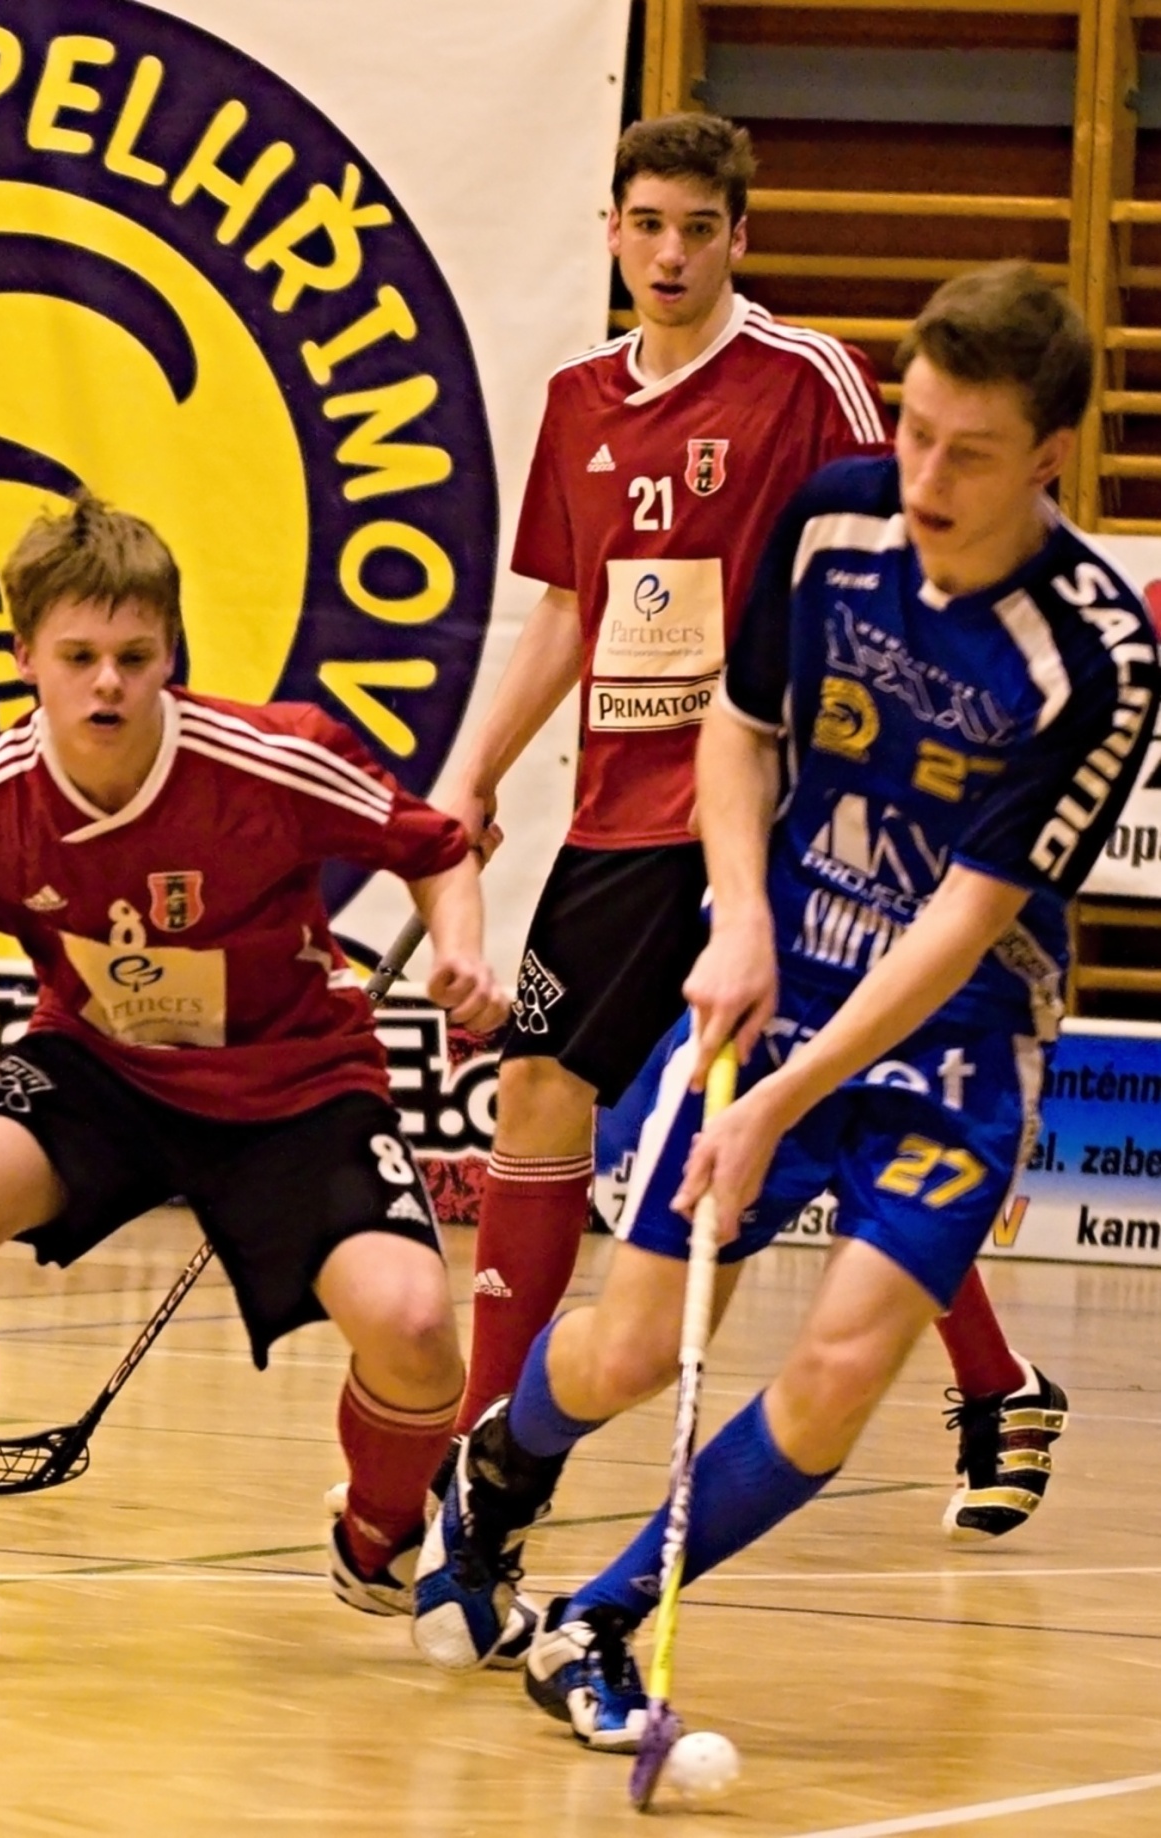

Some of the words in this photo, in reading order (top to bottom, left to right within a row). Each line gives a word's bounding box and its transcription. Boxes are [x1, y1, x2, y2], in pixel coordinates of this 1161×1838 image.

[627, 475, 674, 531] 21
[609, 620, 705, 644] Partners
[598, 690, 711, 721] PRIMATOR
[107, 898, 147, 950] 8
[369, 1133, 415, 1185] 8
[874, 1134, 988, 1209] 27
